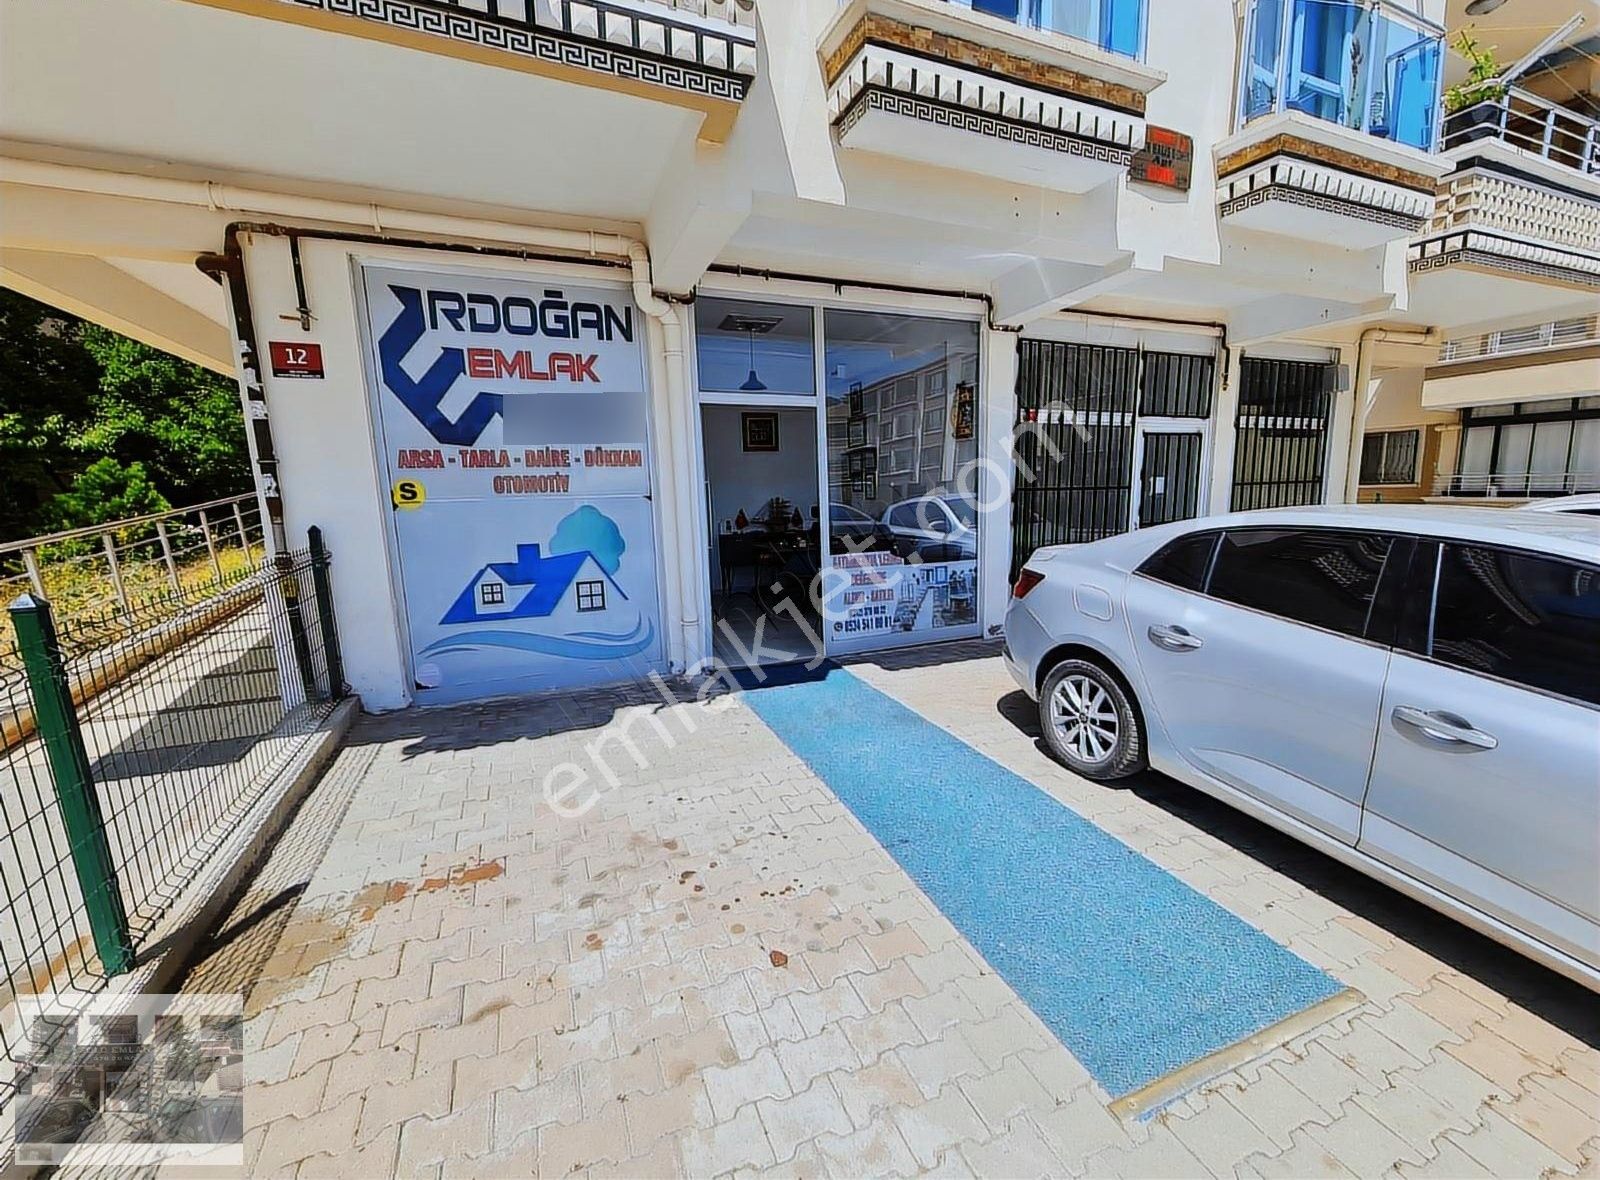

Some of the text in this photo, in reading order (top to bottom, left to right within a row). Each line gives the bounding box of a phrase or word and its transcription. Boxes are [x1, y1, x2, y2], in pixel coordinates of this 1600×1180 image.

[285, 348, 308, 365] 12
[467, 347, 601, 383] EMLAK
[397, 449, 446, 469] ARSA
[459, 448, 511, 468] TARLA
[525, 445, 571, 468] DAİRE
